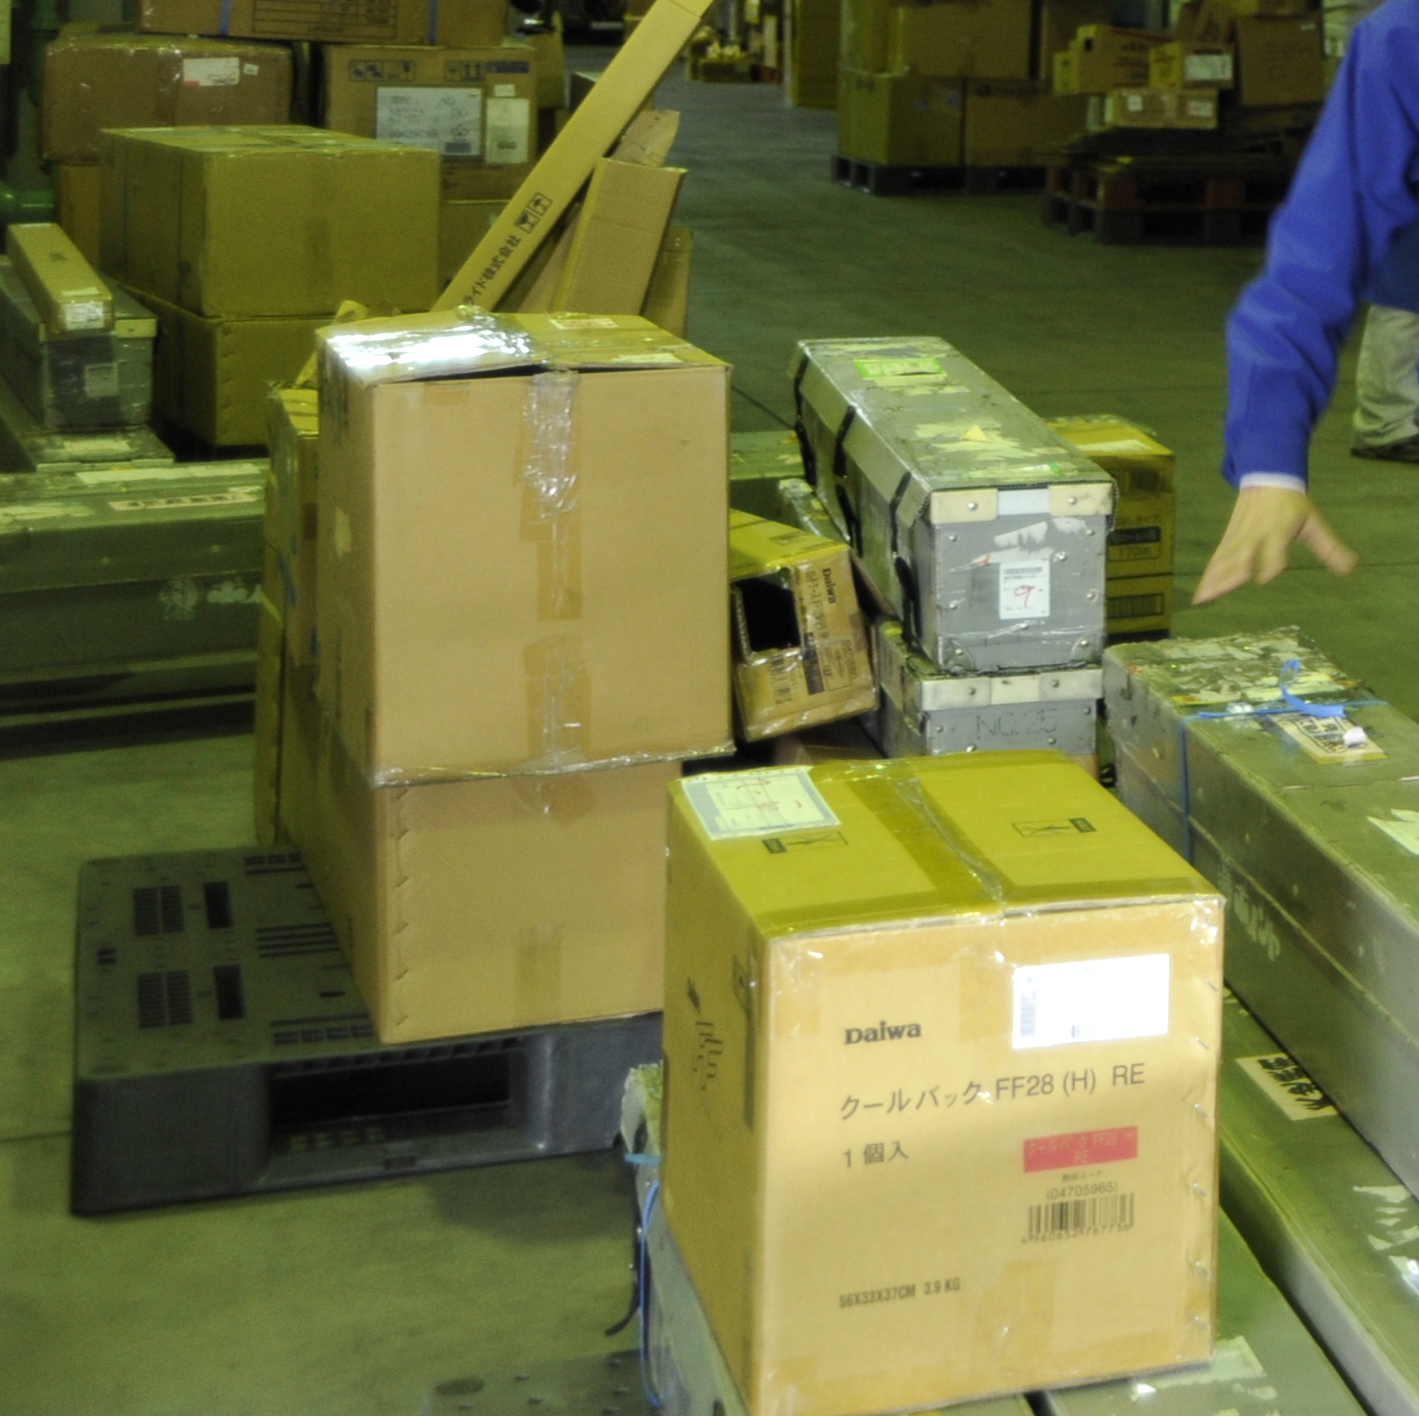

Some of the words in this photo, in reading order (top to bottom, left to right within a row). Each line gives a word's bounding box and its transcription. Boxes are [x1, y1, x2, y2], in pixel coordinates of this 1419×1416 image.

[822, 567, 837, 604] Daiwa
[845, 1020, 922, 1045] Daiwa
[839, 1080, 982, 1121] クールバック
[995, 1073, 1055, 1100] FF28
[1062, 1068, 1097, 1095] (H)
[1112, 1062, 1145, 1087] RE
[944, 1277, 961, 1292] KG
